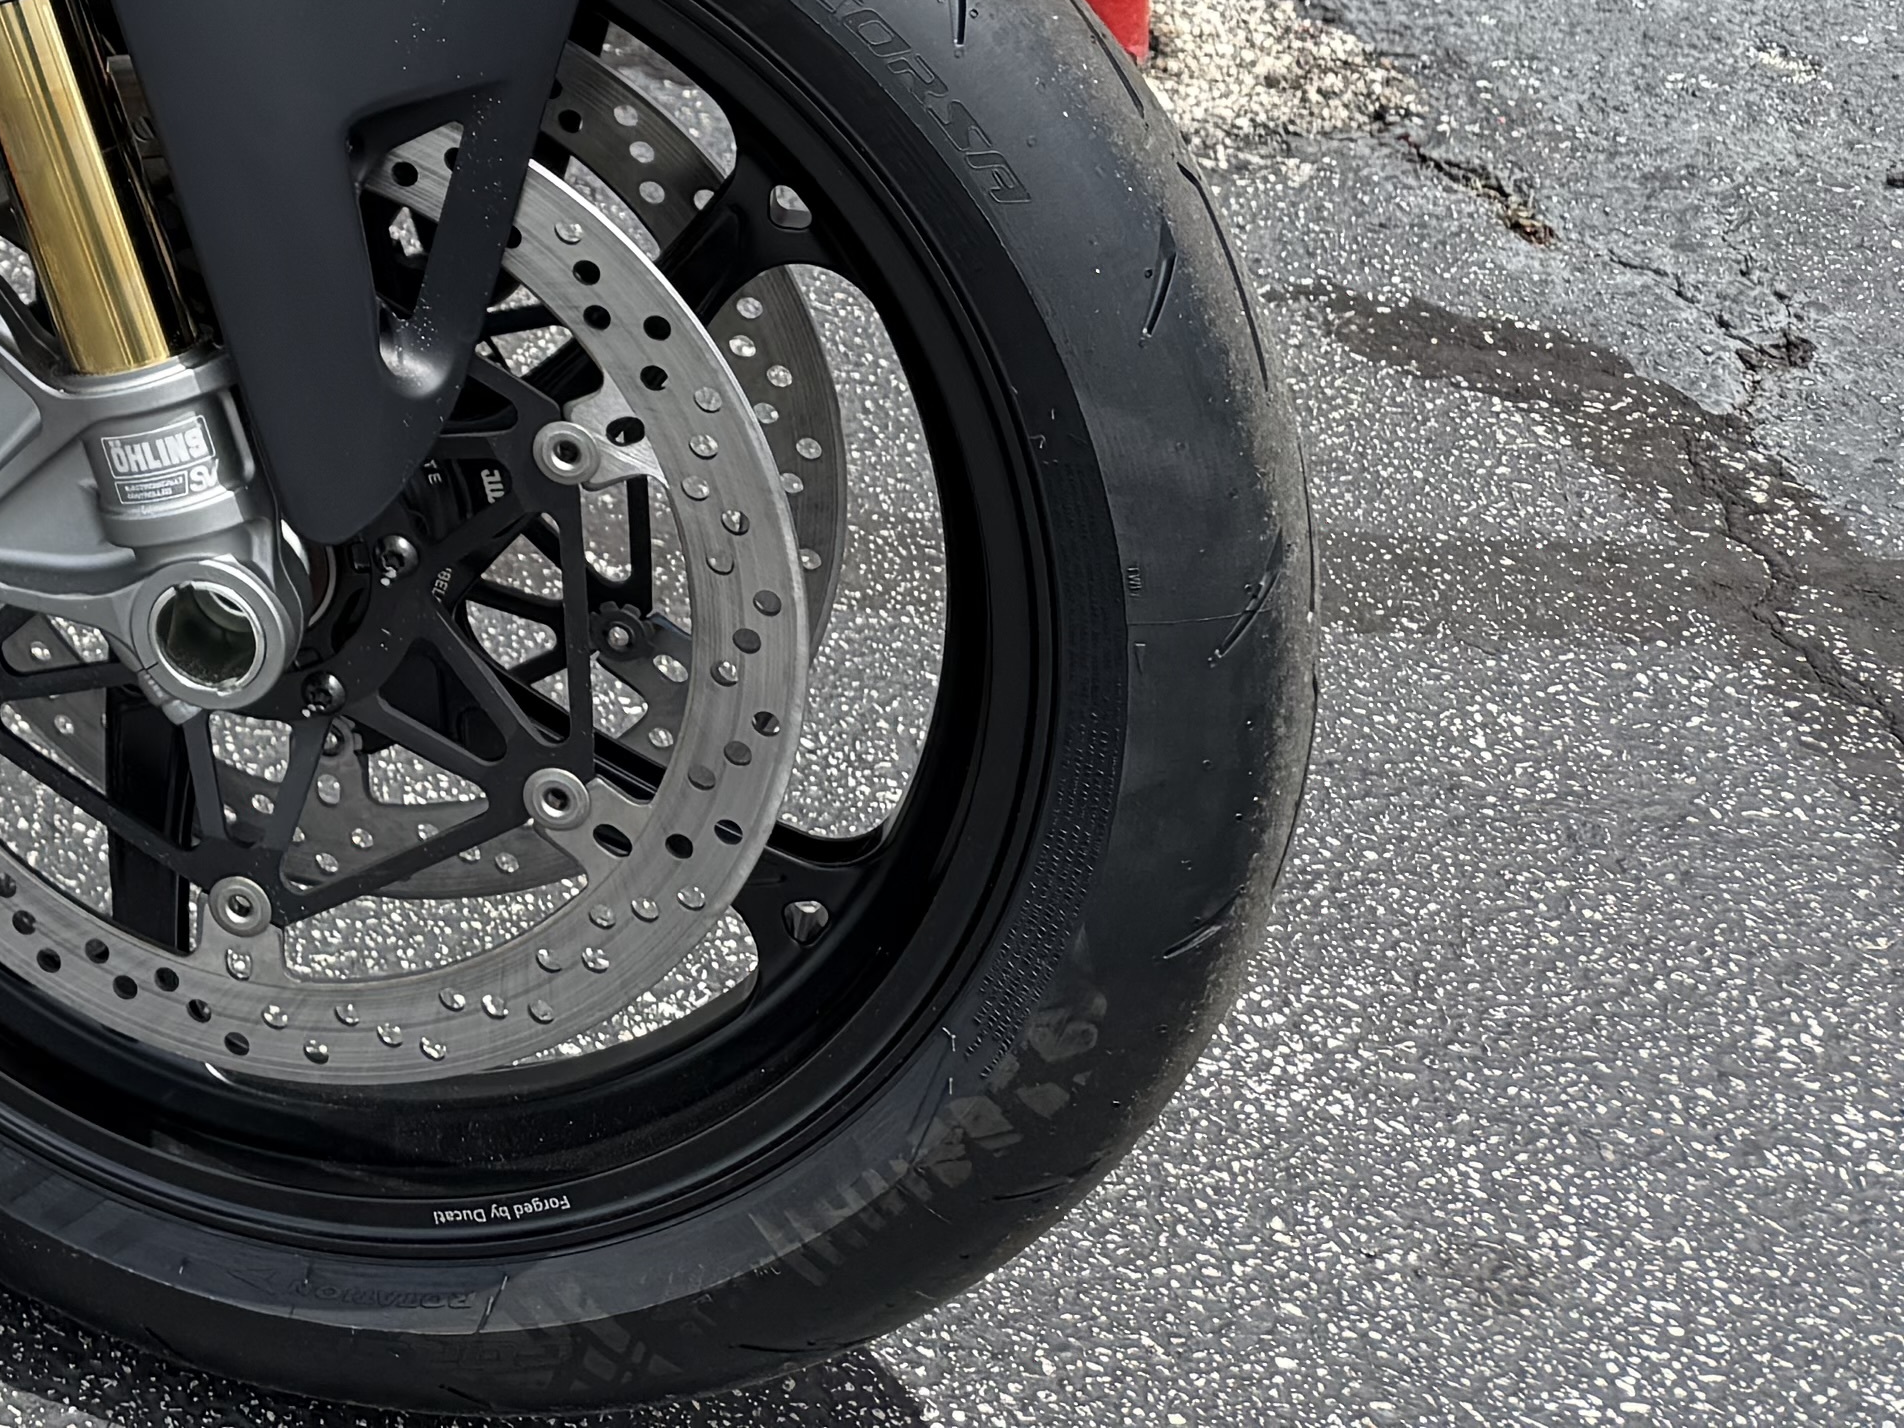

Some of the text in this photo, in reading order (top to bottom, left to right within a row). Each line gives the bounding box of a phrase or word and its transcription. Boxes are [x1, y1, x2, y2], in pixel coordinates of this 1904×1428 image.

[107, 425, 211, 474] ÖHLINS
[433, 1195, 571, 1225] Forged by Ducati
